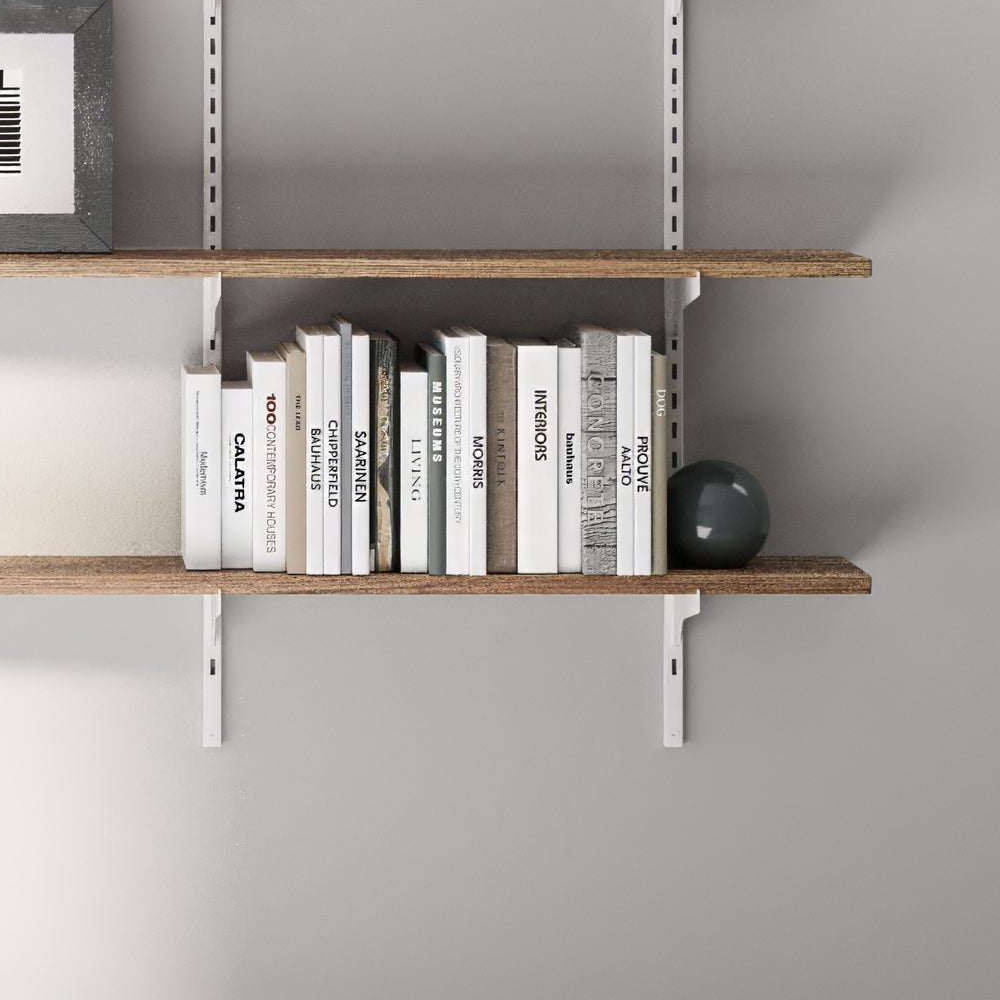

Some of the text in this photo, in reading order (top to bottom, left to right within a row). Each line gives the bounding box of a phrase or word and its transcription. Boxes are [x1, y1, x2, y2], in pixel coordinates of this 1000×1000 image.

[432, 381, 442, 463] MUSEUMS
[534, 389, 548, 462] INTERIORS
[656, 388, 666, 418] DOG
[234, 432, 245, 513] CALATRA
[310, 428, 321, 491] BAUHAUS
[328, 419, 339, 508] CHIPPERFIELD
[355, 430, 367, 503] SAARINEN
[411, 438, 422, 502] LIVING
[472, 436, 484, 489] MORRIS
[496, 427, 506, 488] KINFOLK
[565, 432, 575, 485] bauhaus
[621, 445, 632, 487] AALTO
[637, 436, 649, 493] PROUVE
[265, 511, 277, 554] HOUSES
